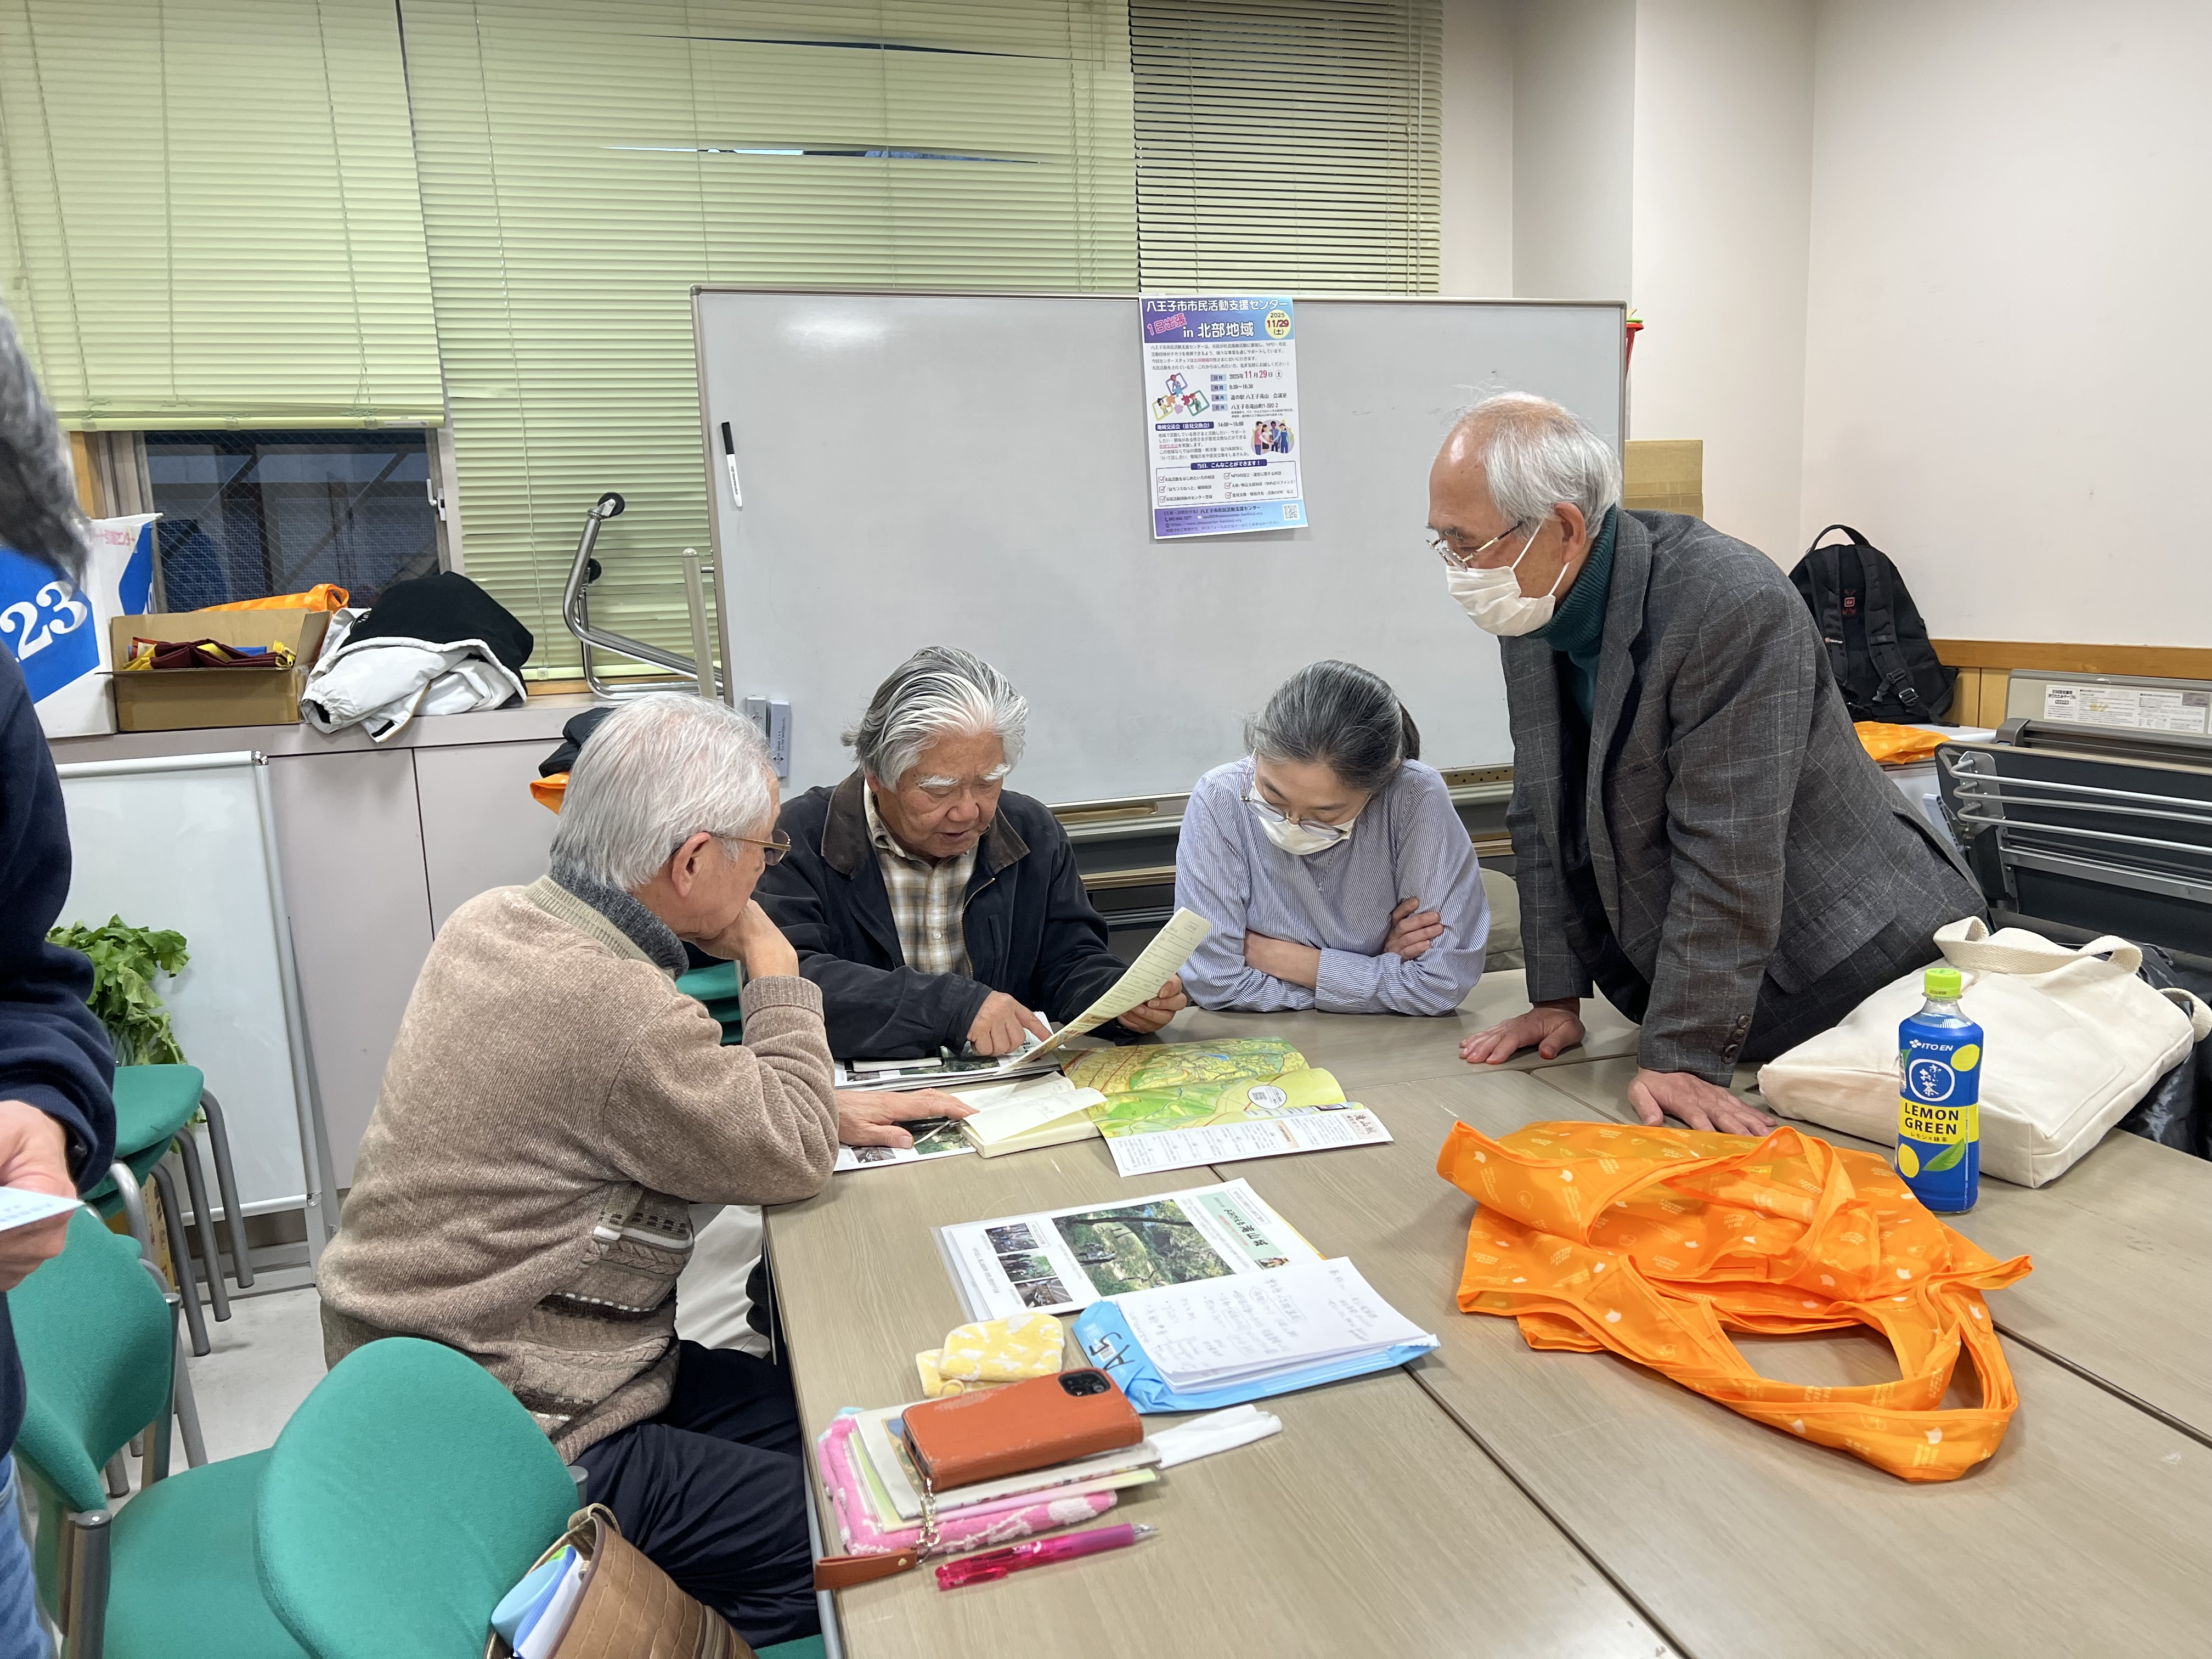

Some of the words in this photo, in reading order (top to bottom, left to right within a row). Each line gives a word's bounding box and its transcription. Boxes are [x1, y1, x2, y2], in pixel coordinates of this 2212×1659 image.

[1147, 300, 1288, 312] 八王子市市民活動支援センター
[1147, 313, 1188, 336] 1日出張
[1183, 326, 1194, 338] in
[1198, 321, 1254, 338] 北部地域
[1267, 320, 1289, 328] 11/29
[1905, 1102, 1959, 1121] LEMON
[1905, 1118, 1957, 1135] GREEN
